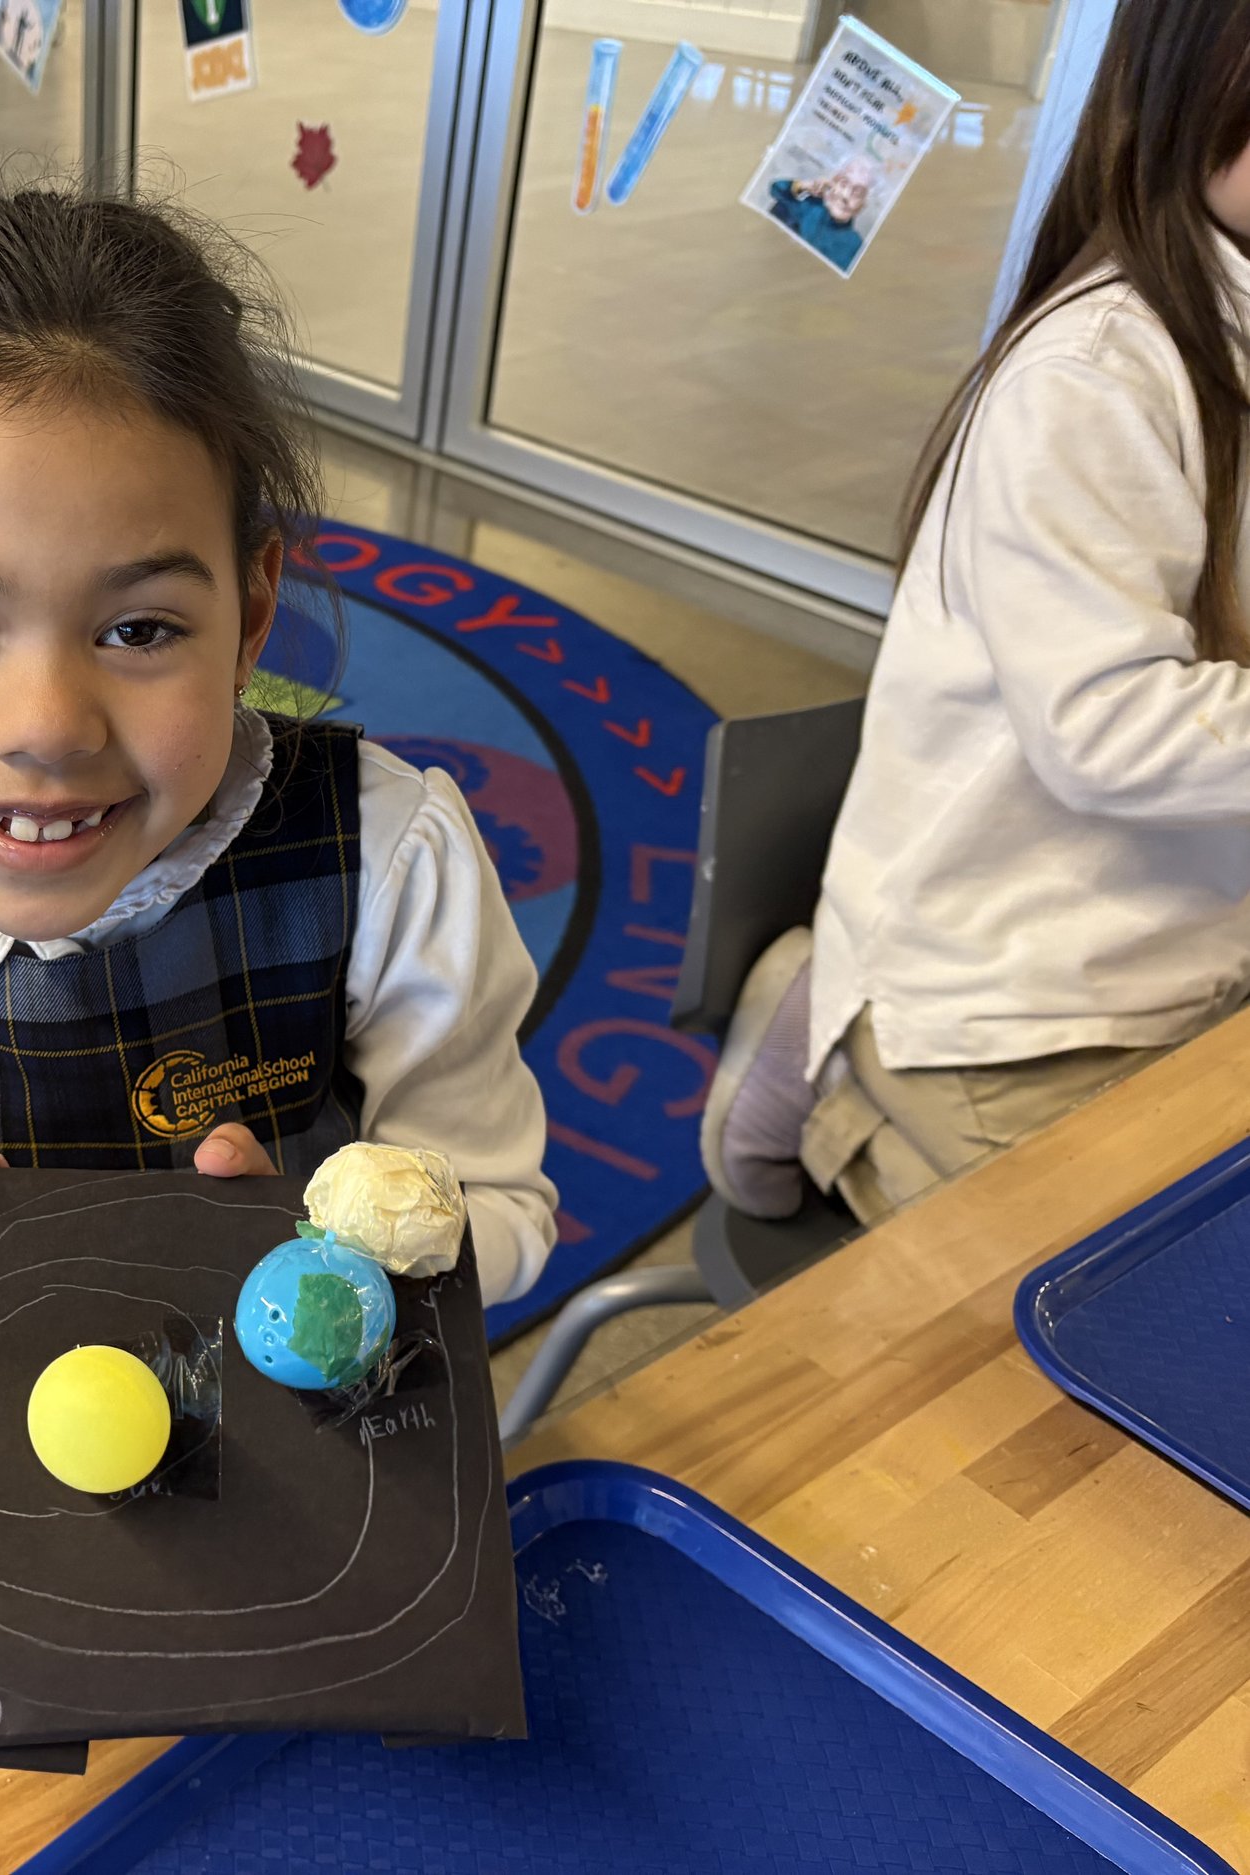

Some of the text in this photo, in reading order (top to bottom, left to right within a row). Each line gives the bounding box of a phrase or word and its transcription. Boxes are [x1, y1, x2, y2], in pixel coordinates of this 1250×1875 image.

[170, 1053, 250, 1088] California
[172, 1050, 316, 1106] International School
[175, 1069, 309, 1118] CAPITAL REGION
